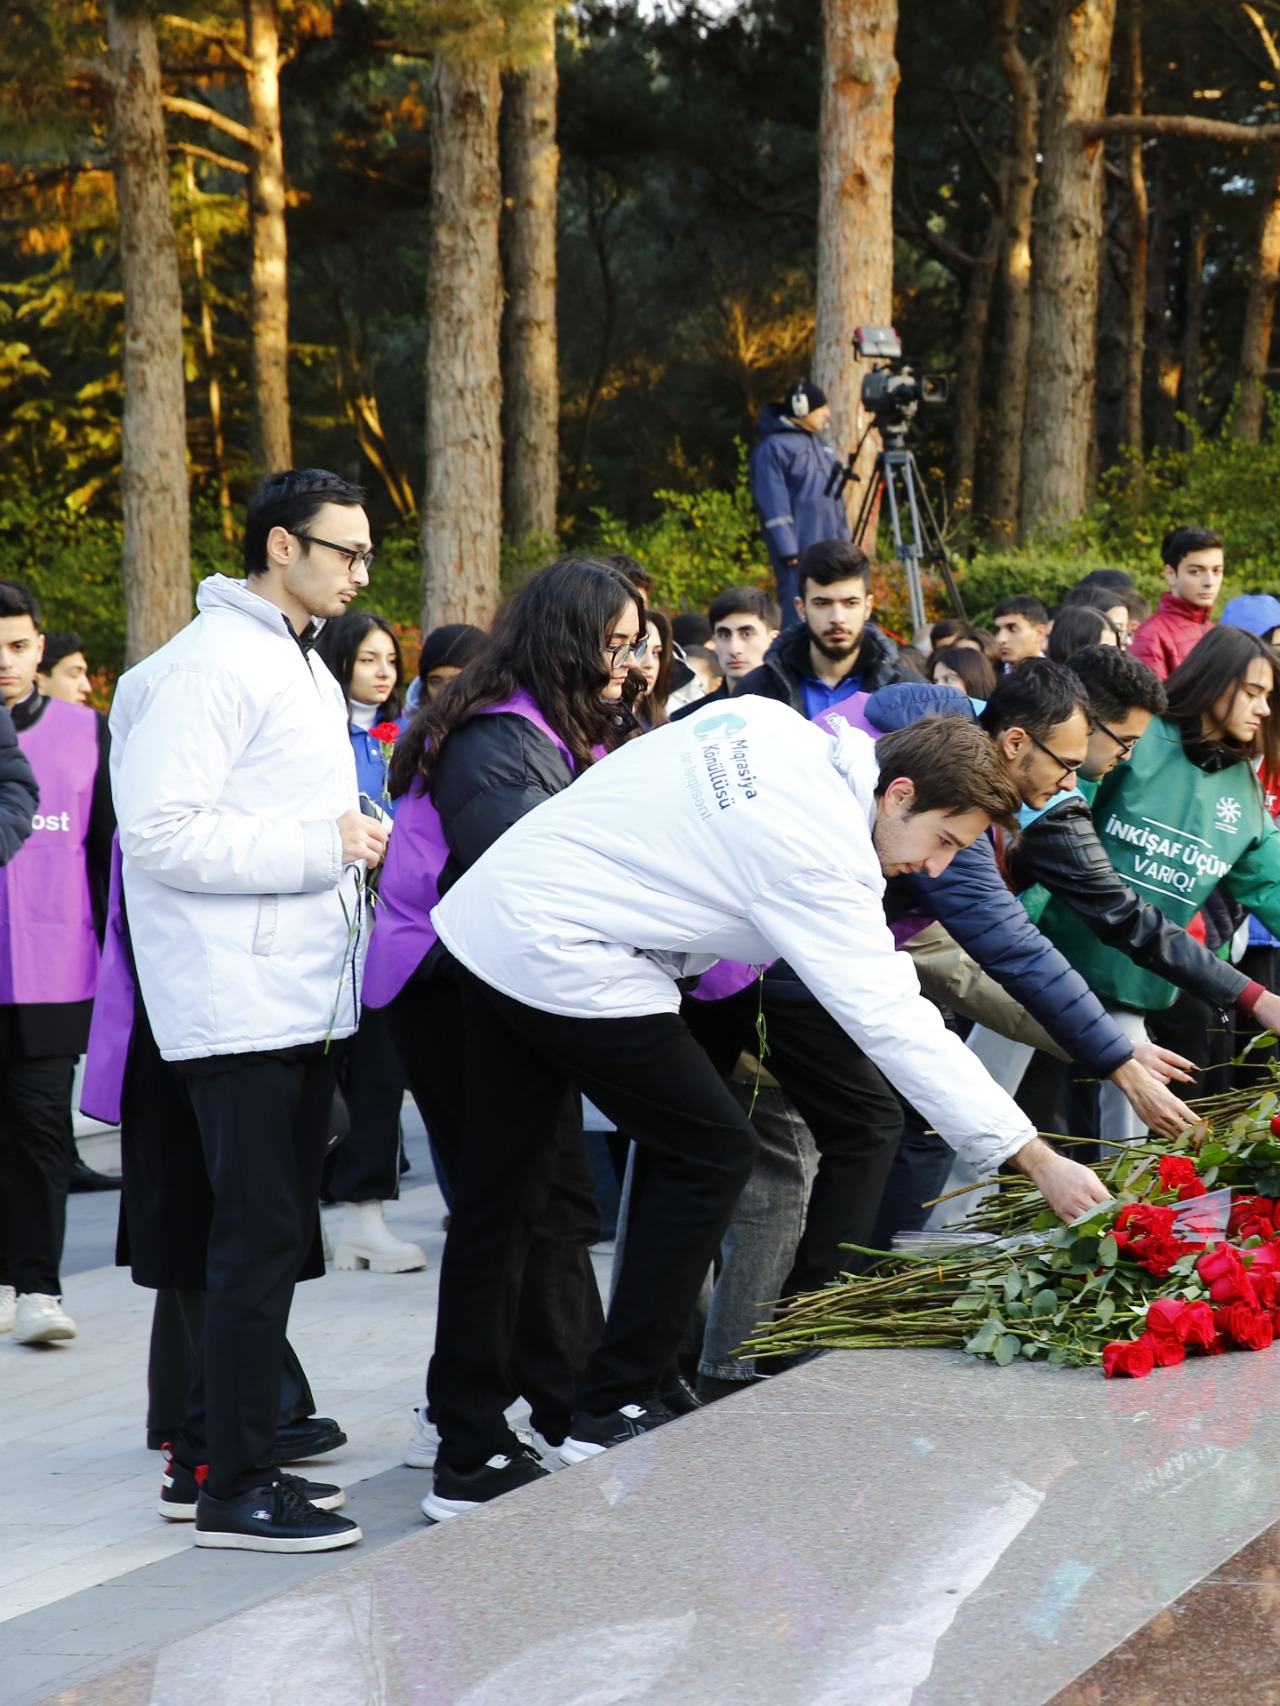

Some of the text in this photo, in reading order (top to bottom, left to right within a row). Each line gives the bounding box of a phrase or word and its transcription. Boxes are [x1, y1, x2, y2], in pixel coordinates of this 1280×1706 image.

[702, 743, 736, 810] Könüllüsü
[729, 739, 758, 800] Miqrasiya
[31, 811, 70, 832] ost
[1264, 789, 1278, 807] ir
[1104, 813, 1233, 879] İNKİŞAF ÜÇÜN
[1133, 854, 1197, 893] VARIQ!
